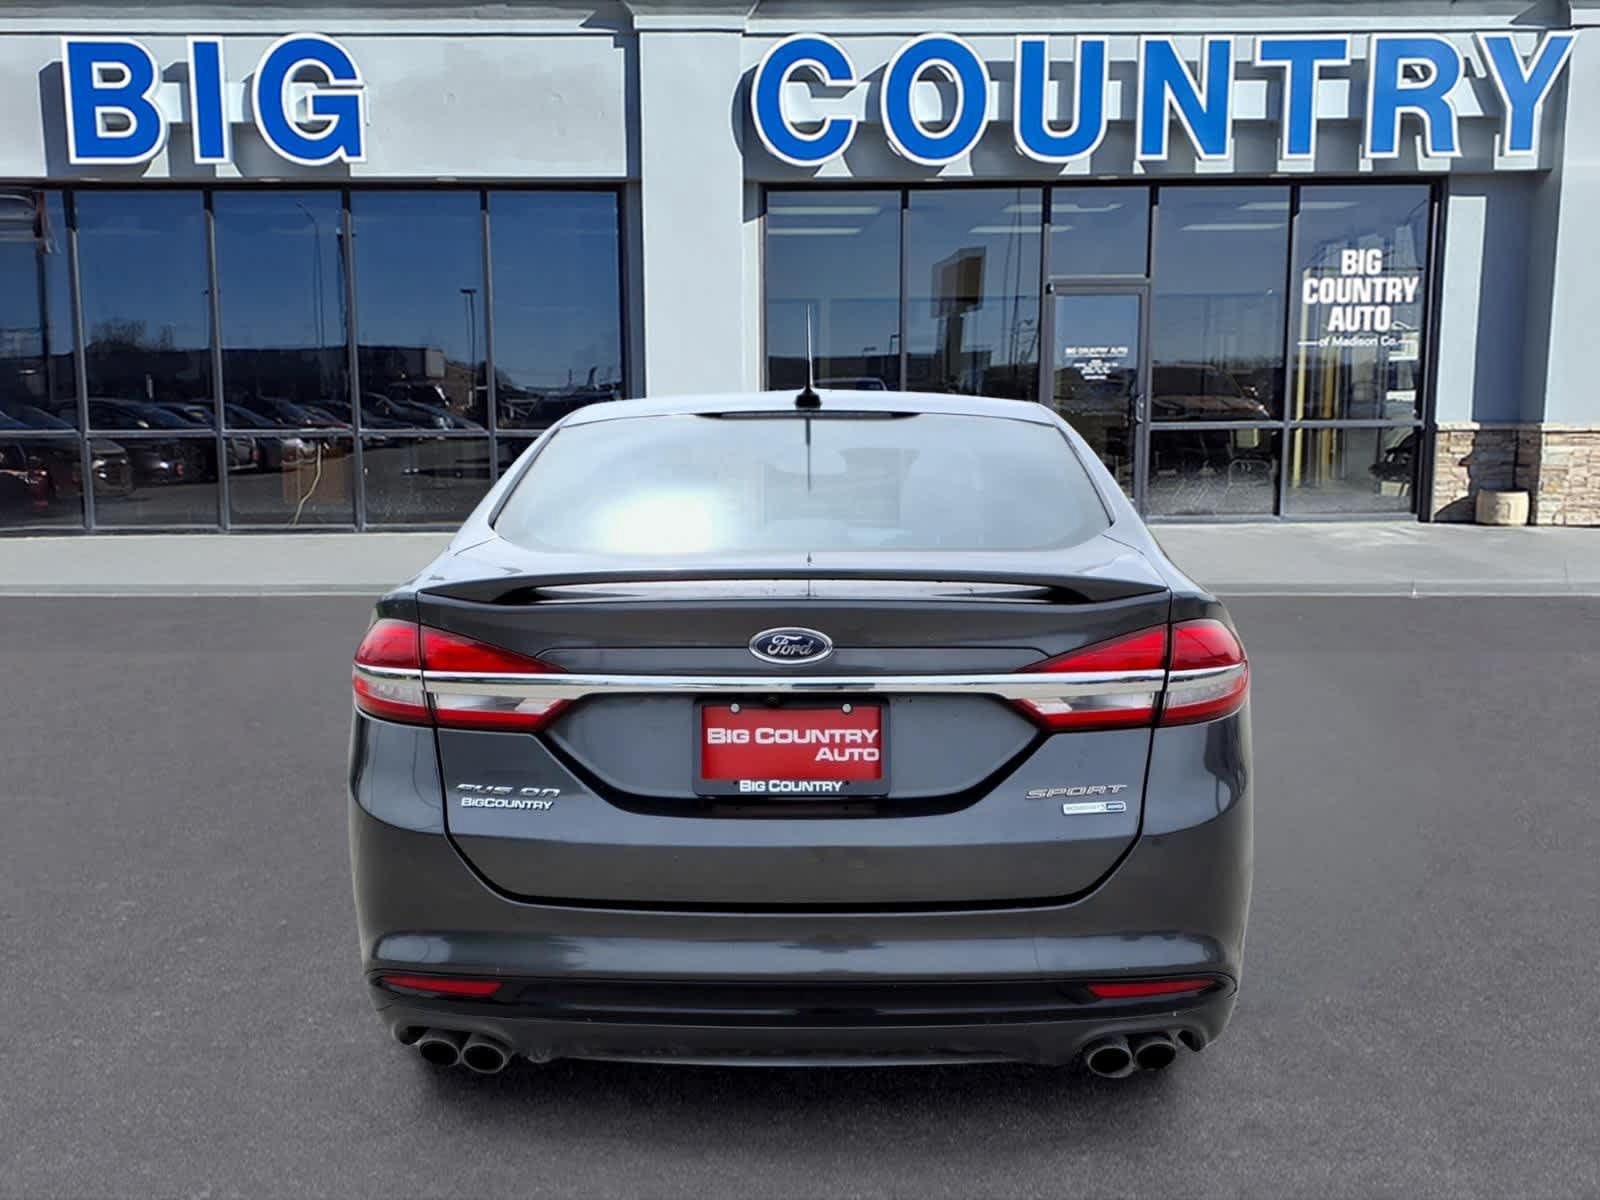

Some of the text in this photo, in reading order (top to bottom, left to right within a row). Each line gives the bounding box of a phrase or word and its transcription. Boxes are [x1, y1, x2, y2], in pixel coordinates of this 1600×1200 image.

[61, 31, 1576, 168] BIG COUNTRY
[1341, 248, 1382, 276] BIG
[1302, 276, 1419, 304] COUNTRY
[1327, 305, 1391, 332] AUTO
[1320, 336, 1330, 347] of
[1331, 336, 1378, 347] Madison
[767, 634, 814, 656] Ford
[815, 748, 879, 761] AUTO
[1025, 784, 1128, 799] SPORT
